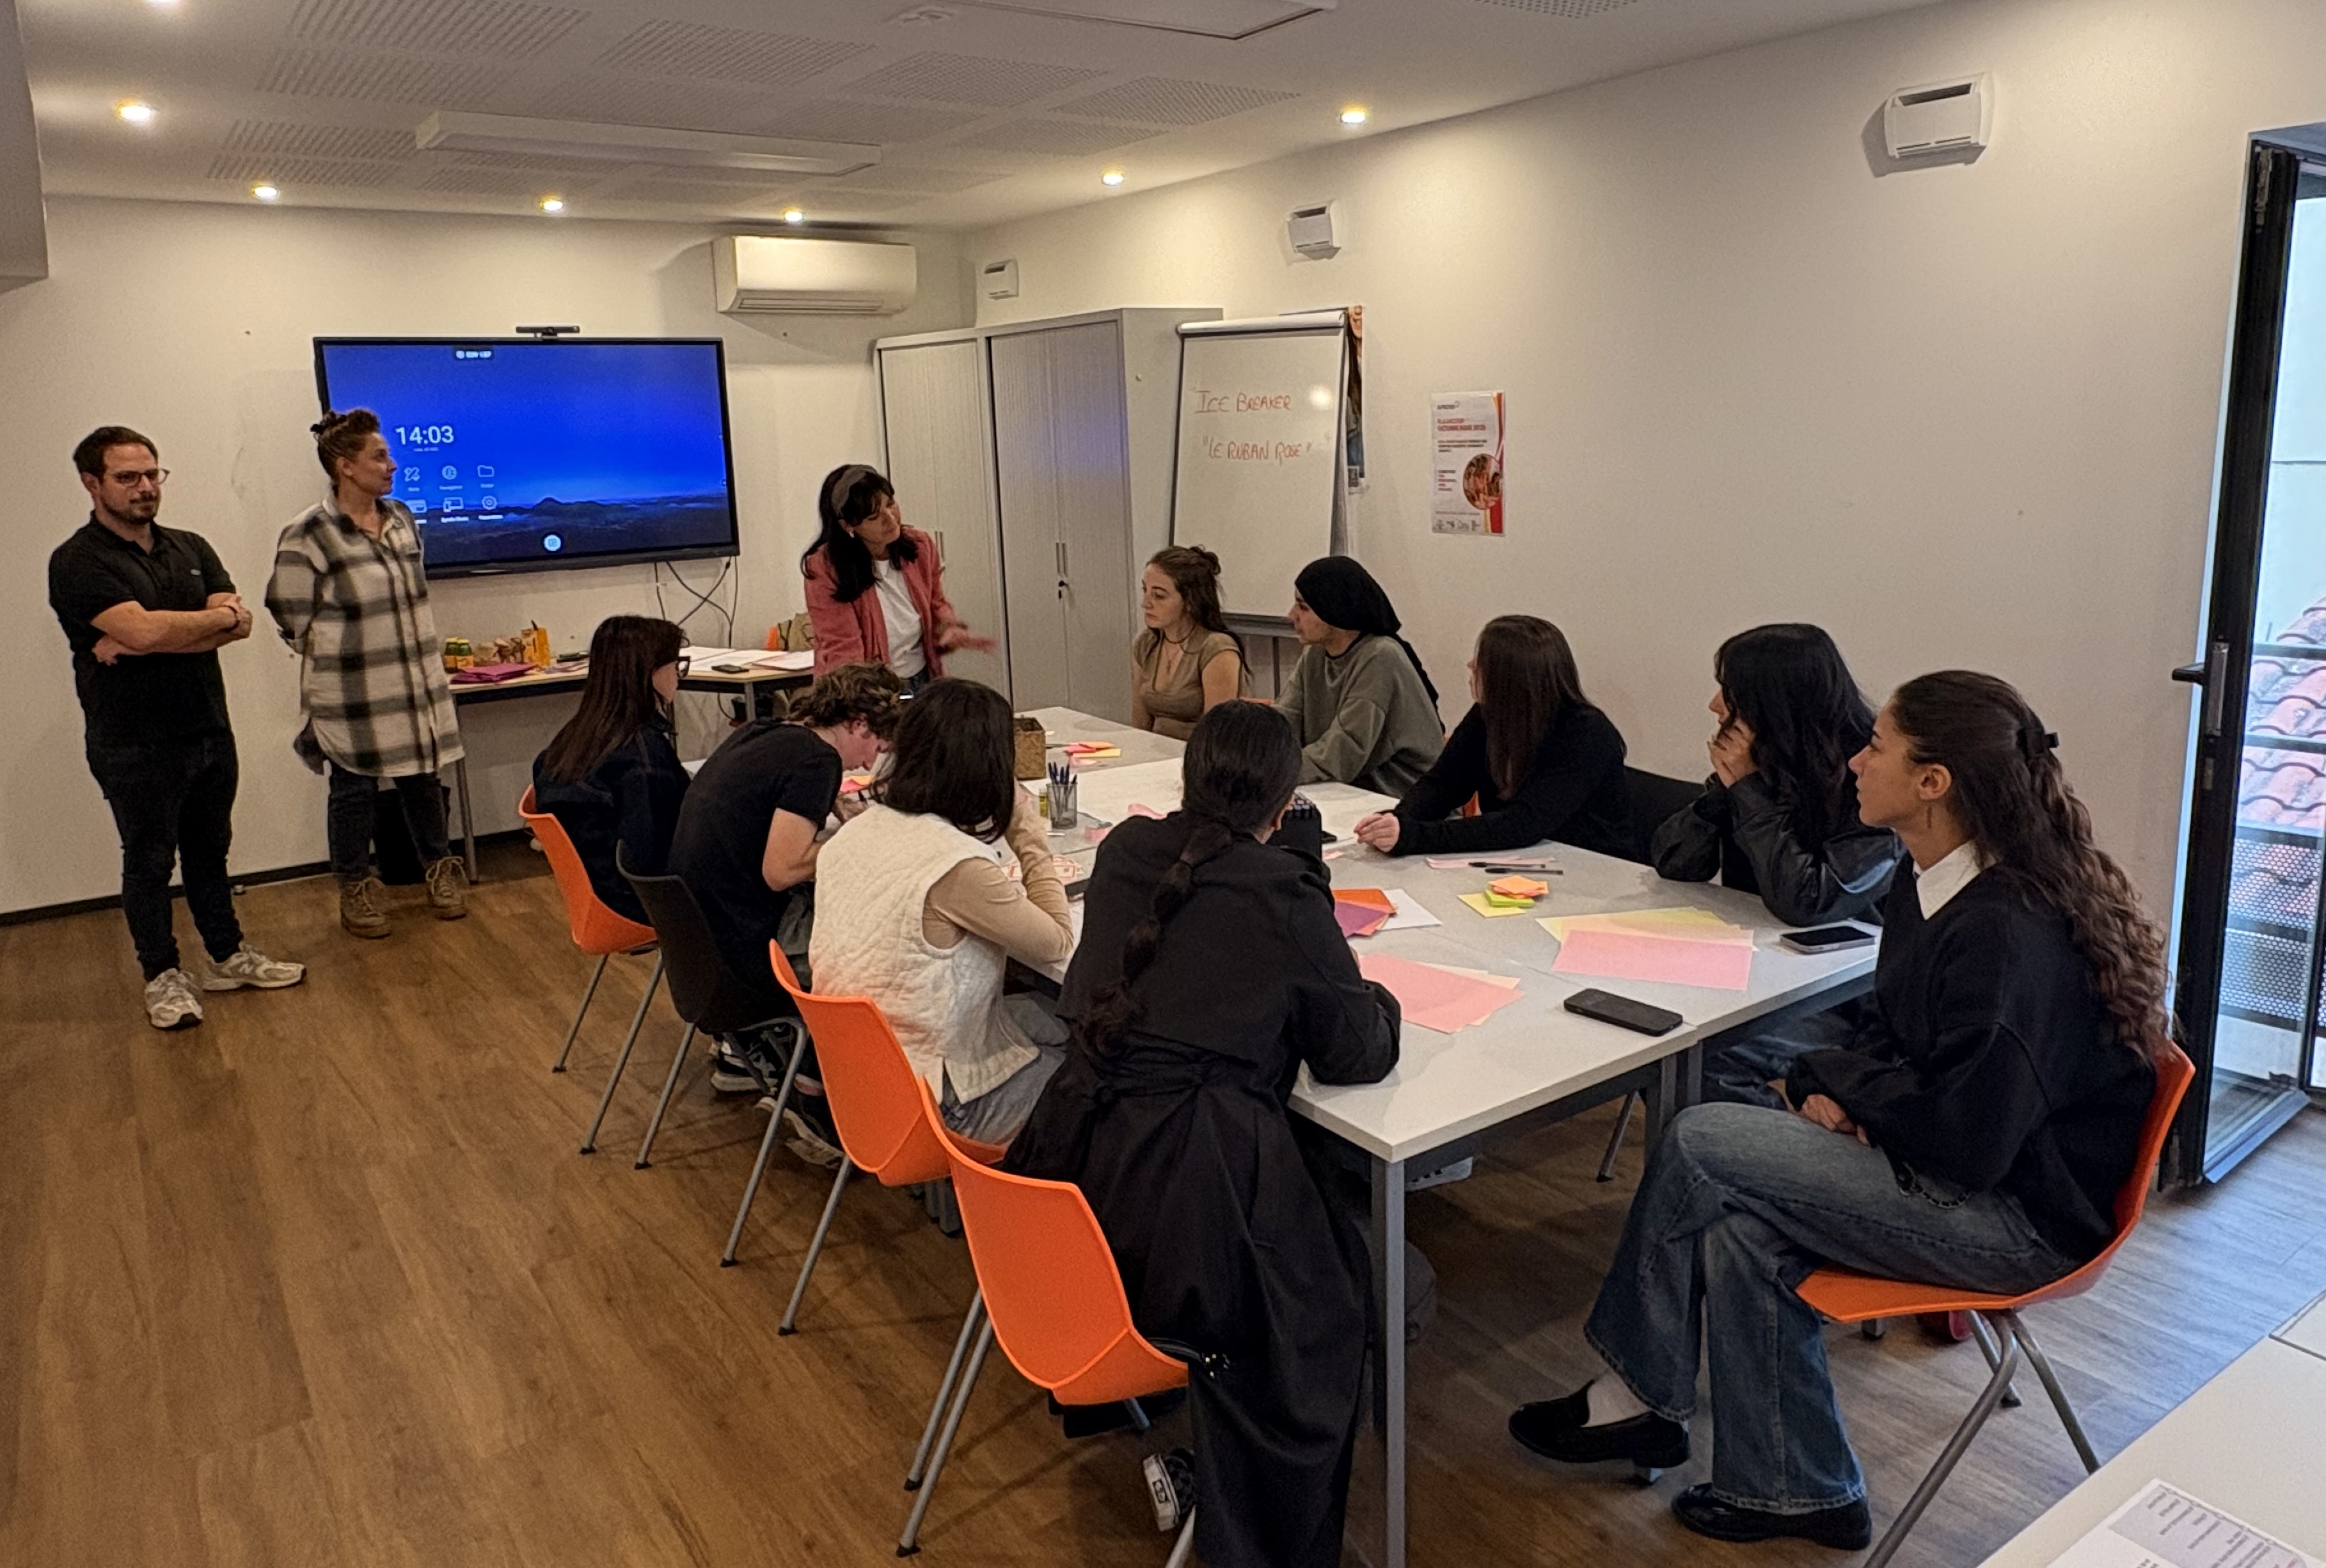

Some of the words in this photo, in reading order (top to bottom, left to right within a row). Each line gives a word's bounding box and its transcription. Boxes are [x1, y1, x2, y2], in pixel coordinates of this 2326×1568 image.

[1195, 391, 1230, 413] ICE
[1237, 392, 1291, 412] BREAKER
[395, 425, 454, 445] 14:03
[1228, 441, 1269, 460] RUBAN
